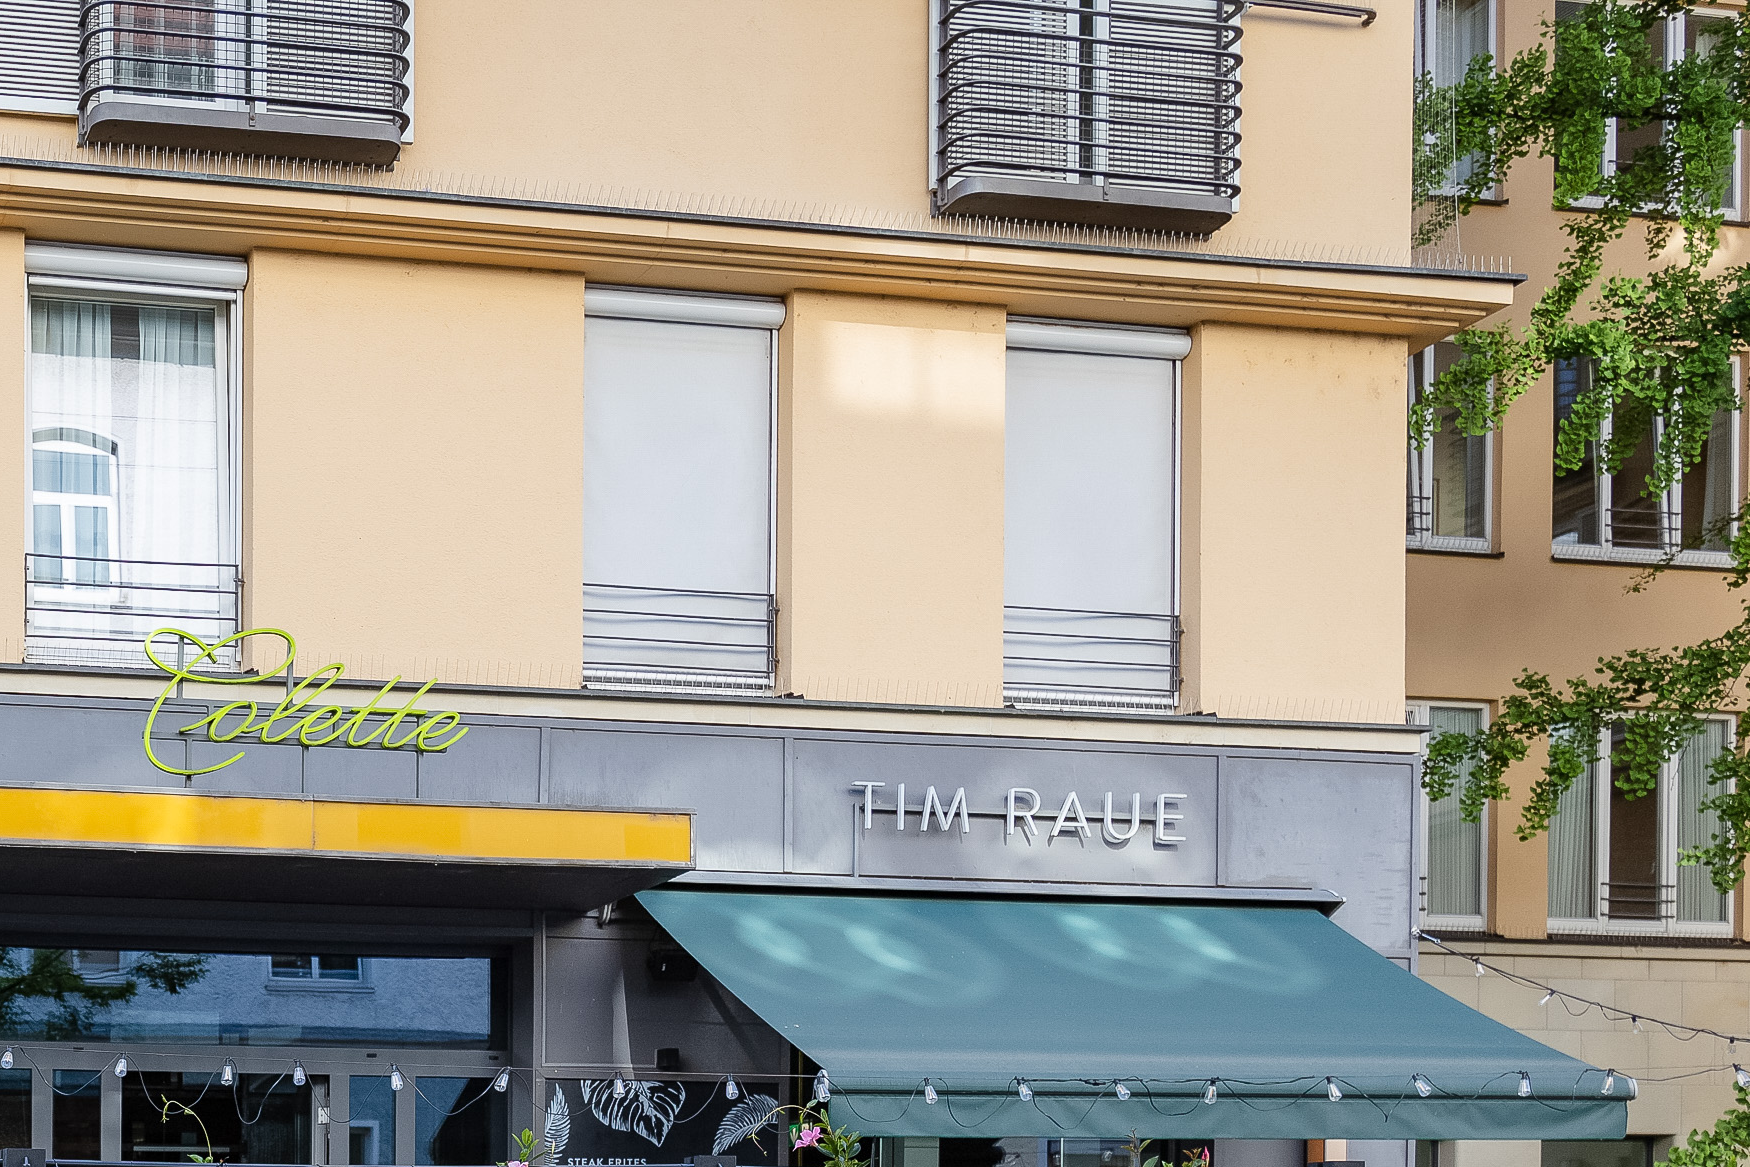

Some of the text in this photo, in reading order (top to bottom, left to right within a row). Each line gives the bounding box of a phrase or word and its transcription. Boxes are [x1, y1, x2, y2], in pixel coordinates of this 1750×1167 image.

[145, 627, 470, 776] Colette
[851, 780, 1188, 844] TIM RAUE
[567, 1158, 604, 1166] STEAK
